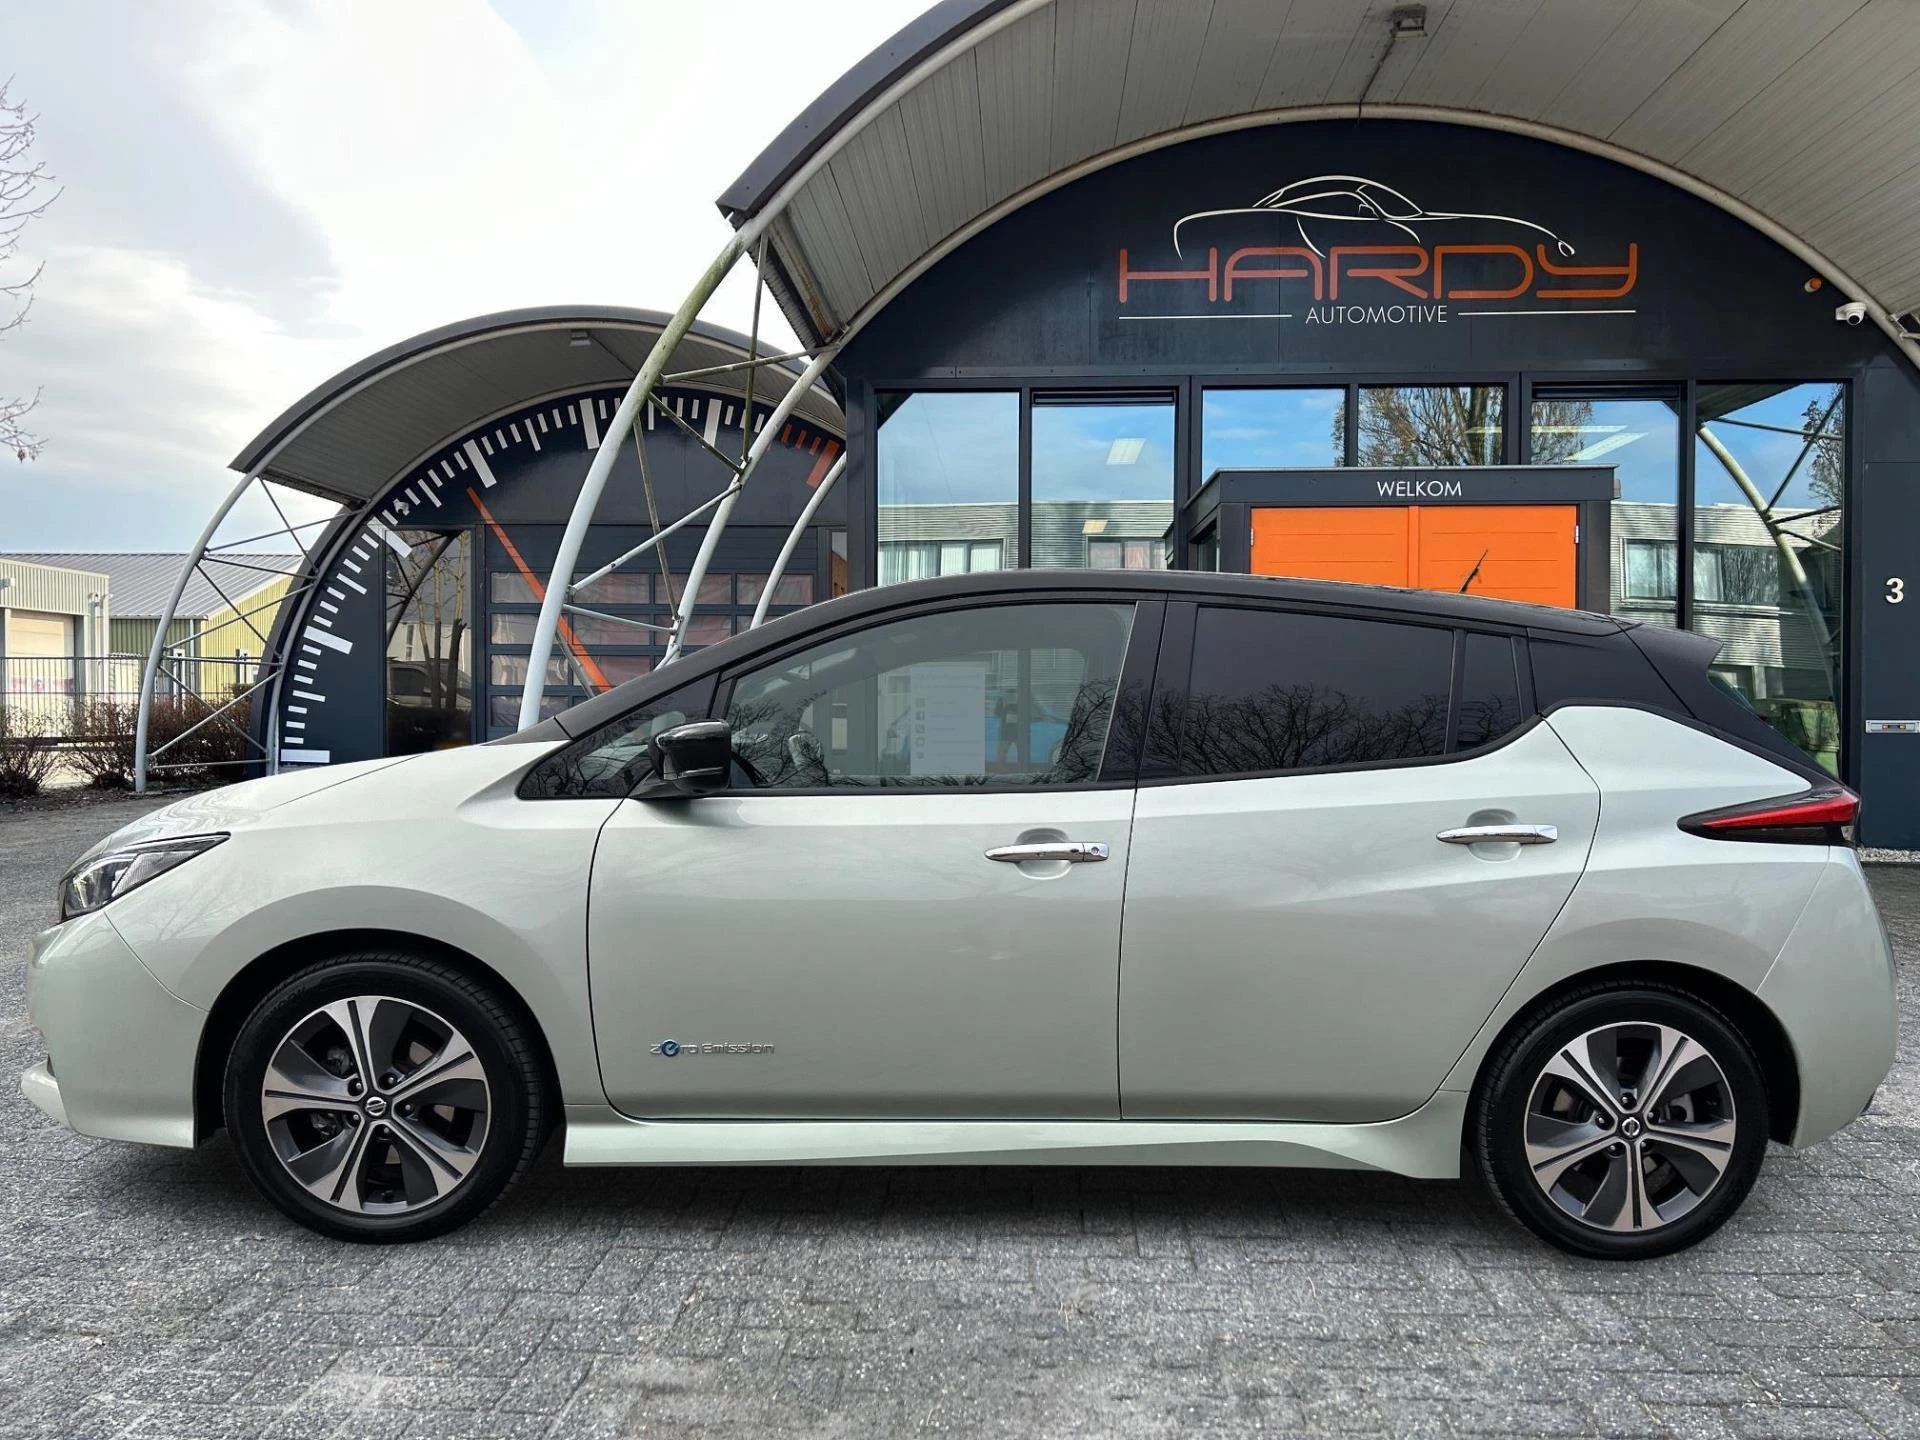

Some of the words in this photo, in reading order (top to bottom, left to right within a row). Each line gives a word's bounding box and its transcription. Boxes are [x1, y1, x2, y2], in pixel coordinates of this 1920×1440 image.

[1119, 243, 1638, 303] HARDY
[1305, 305, 1448, 325] AUTOMOTIVE
[1376, 481, 1462, 497] WELKOM
[1885, 577, 1905, 604] 3
